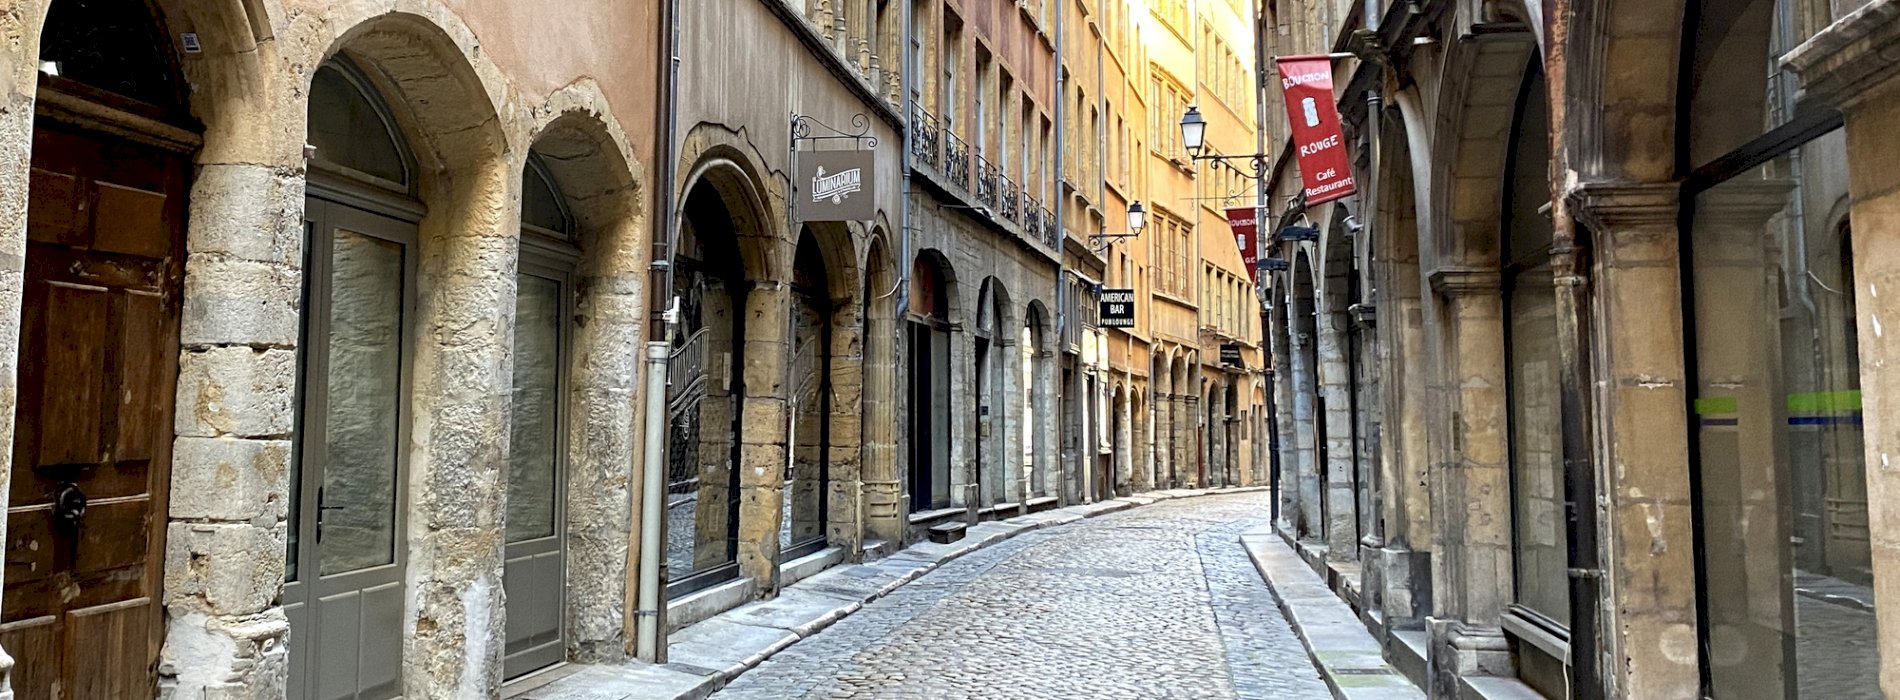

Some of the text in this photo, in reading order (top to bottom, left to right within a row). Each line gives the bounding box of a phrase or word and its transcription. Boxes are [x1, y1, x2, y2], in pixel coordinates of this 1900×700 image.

[1282, 71, 1330, 90] BOUCHON
[1300, 134, 1339, 157] ROUGE
[812, 168, 860, 194] LUMINARIUM
[1316, 168, 1336, 182] Café
[1305, 176, 1353, 197] Restaurant
[1100, 293, 1133, 303] AMERICAN
[1110, 304, 1124, 314] BAR
